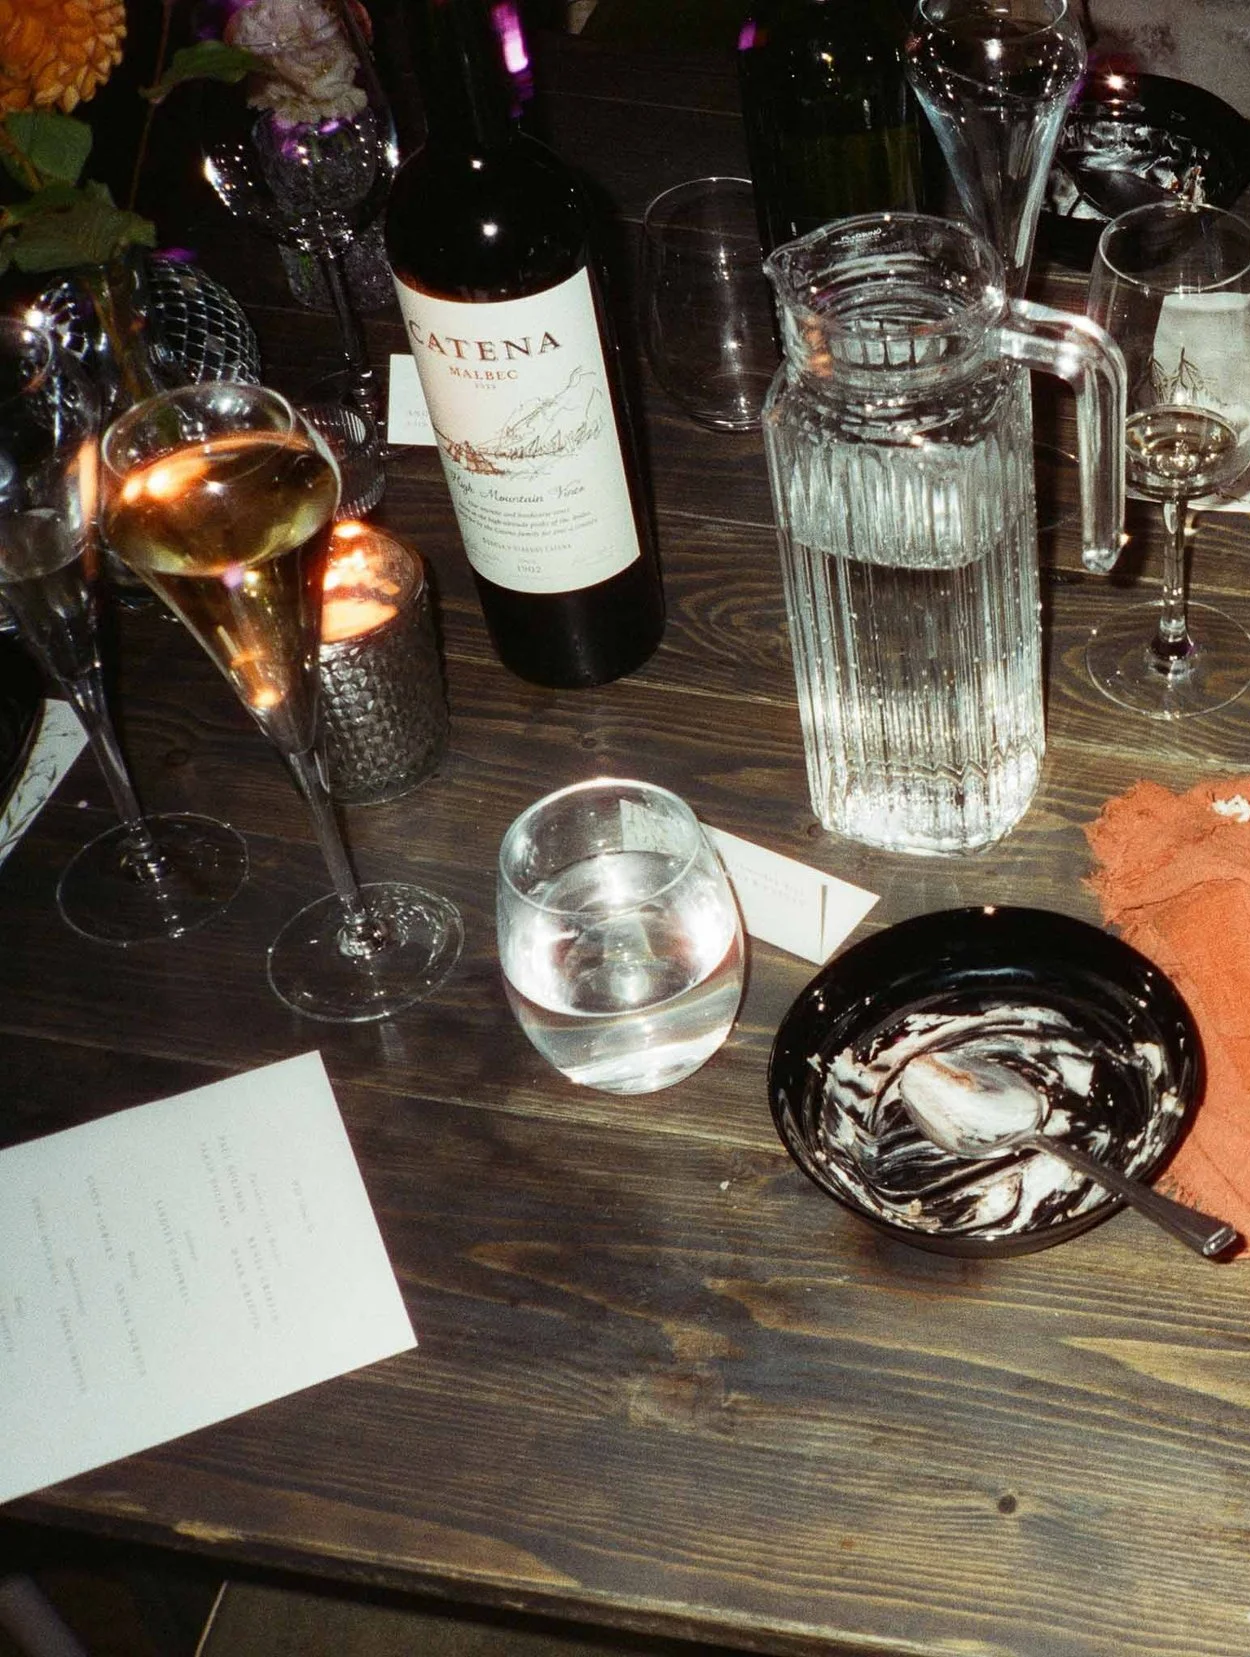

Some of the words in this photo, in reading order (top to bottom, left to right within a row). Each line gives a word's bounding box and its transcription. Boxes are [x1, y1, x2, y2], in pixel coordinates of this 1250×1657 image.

[408, 319, 563, 362] CATENA
[449, 366, 519, 381] MALBEC
[451, 474, 473, 496] High
[480, 488, 544, 504] Mountain
